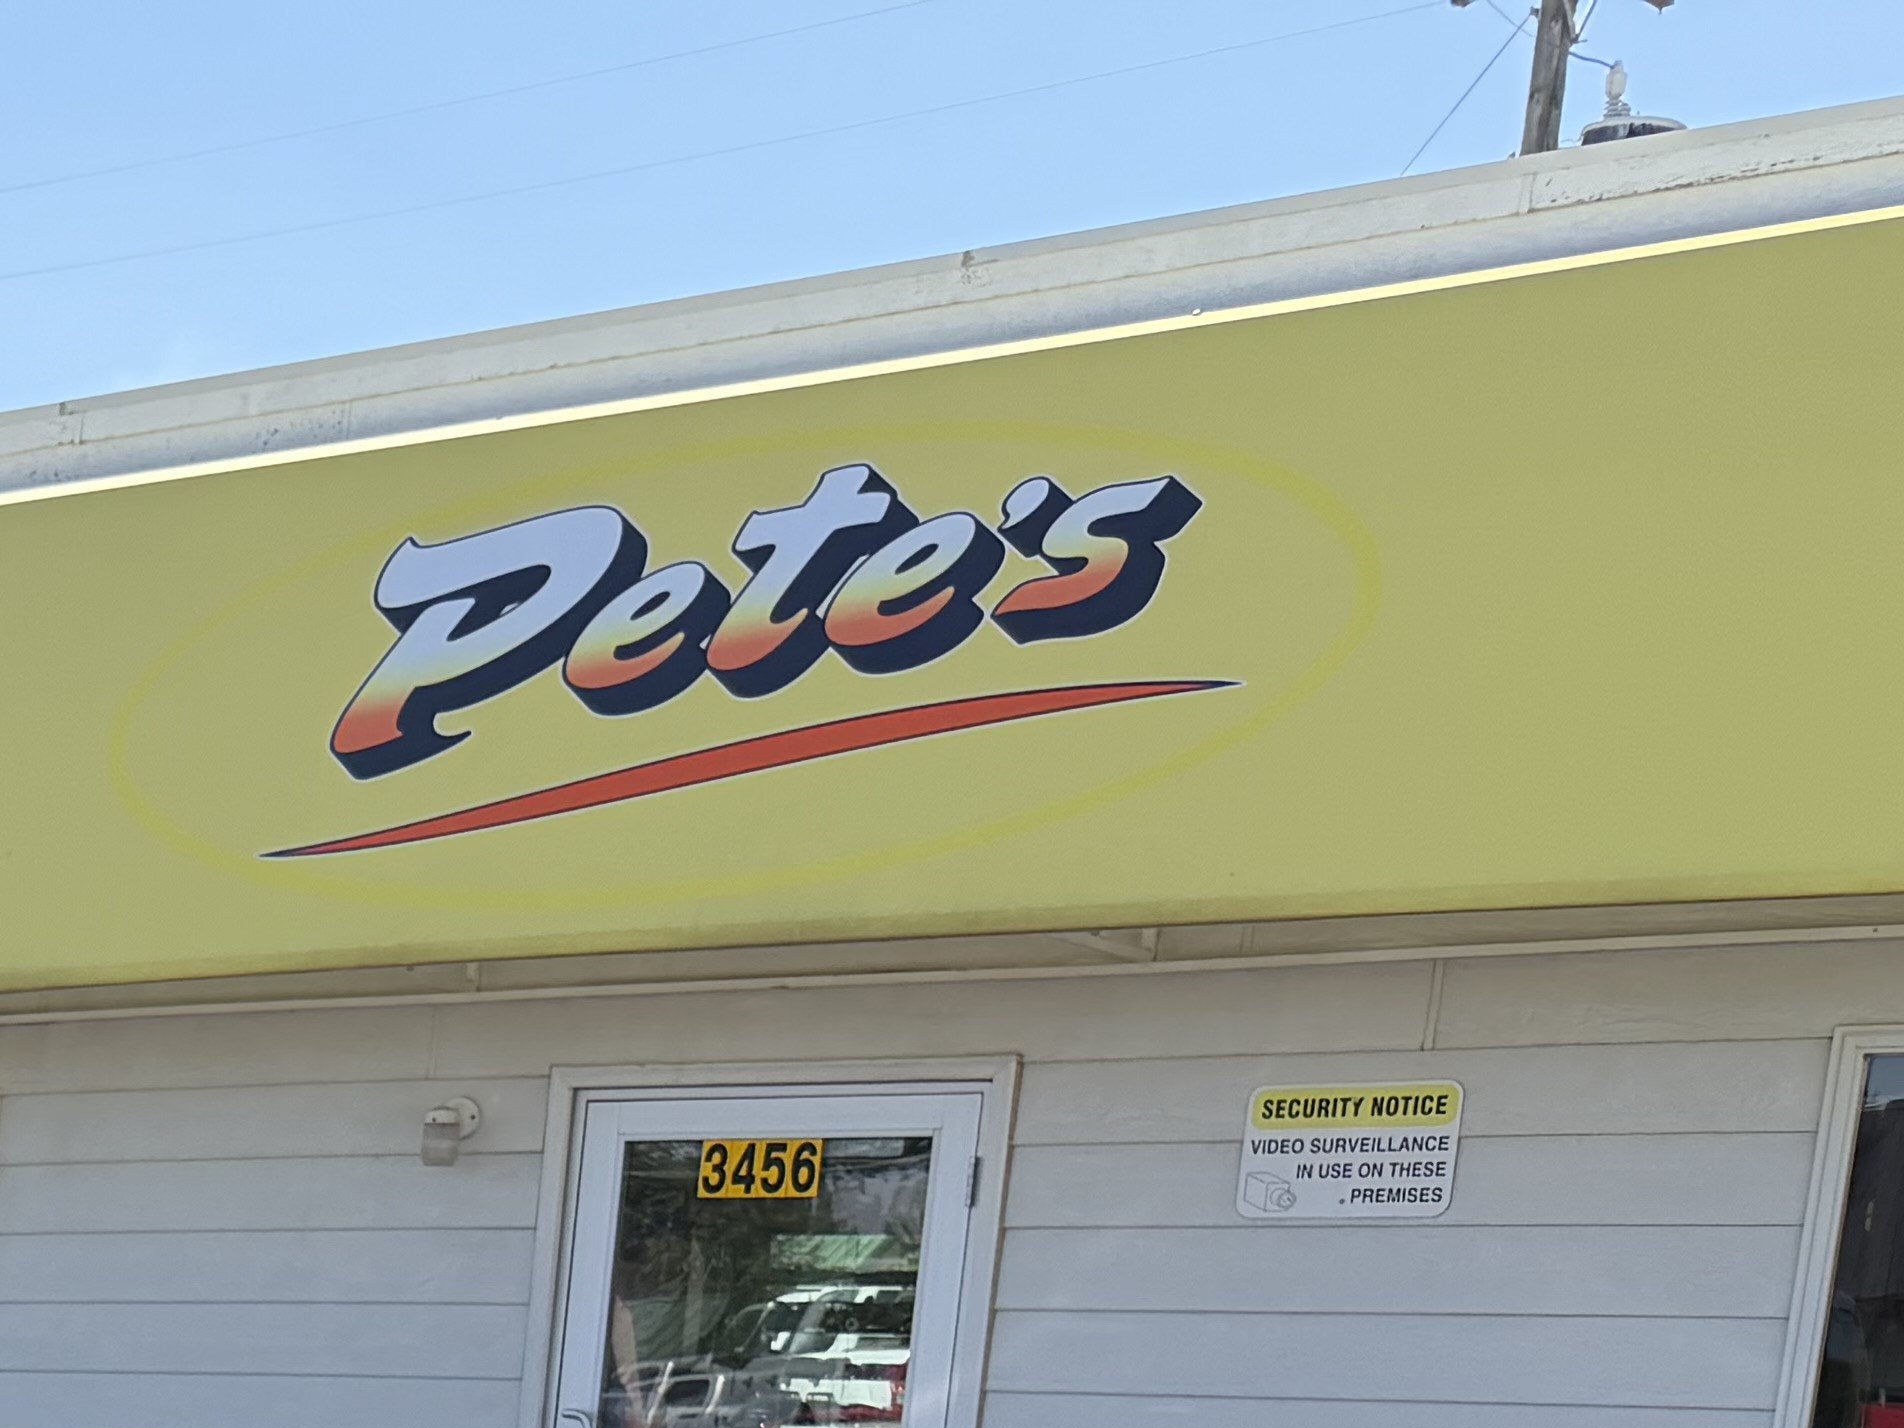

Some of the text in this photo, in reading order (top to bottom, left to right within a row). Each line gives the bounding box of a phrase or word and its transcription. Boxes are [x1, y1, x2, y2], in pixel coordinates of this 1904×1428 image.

[328, 462, 1201, 781] Pete's
[1262, 1094, 1449, 1119] SECURITY NOTICE
[1251, 1135, 1450, 1155] VIDEO SURVEILLANCE
[702, 1142, 818, 1195] 3456
[1296, 1161, 1447, 1179] IN USE ON THESE
[1350, 1187, 1443, 1204] PREMISES
